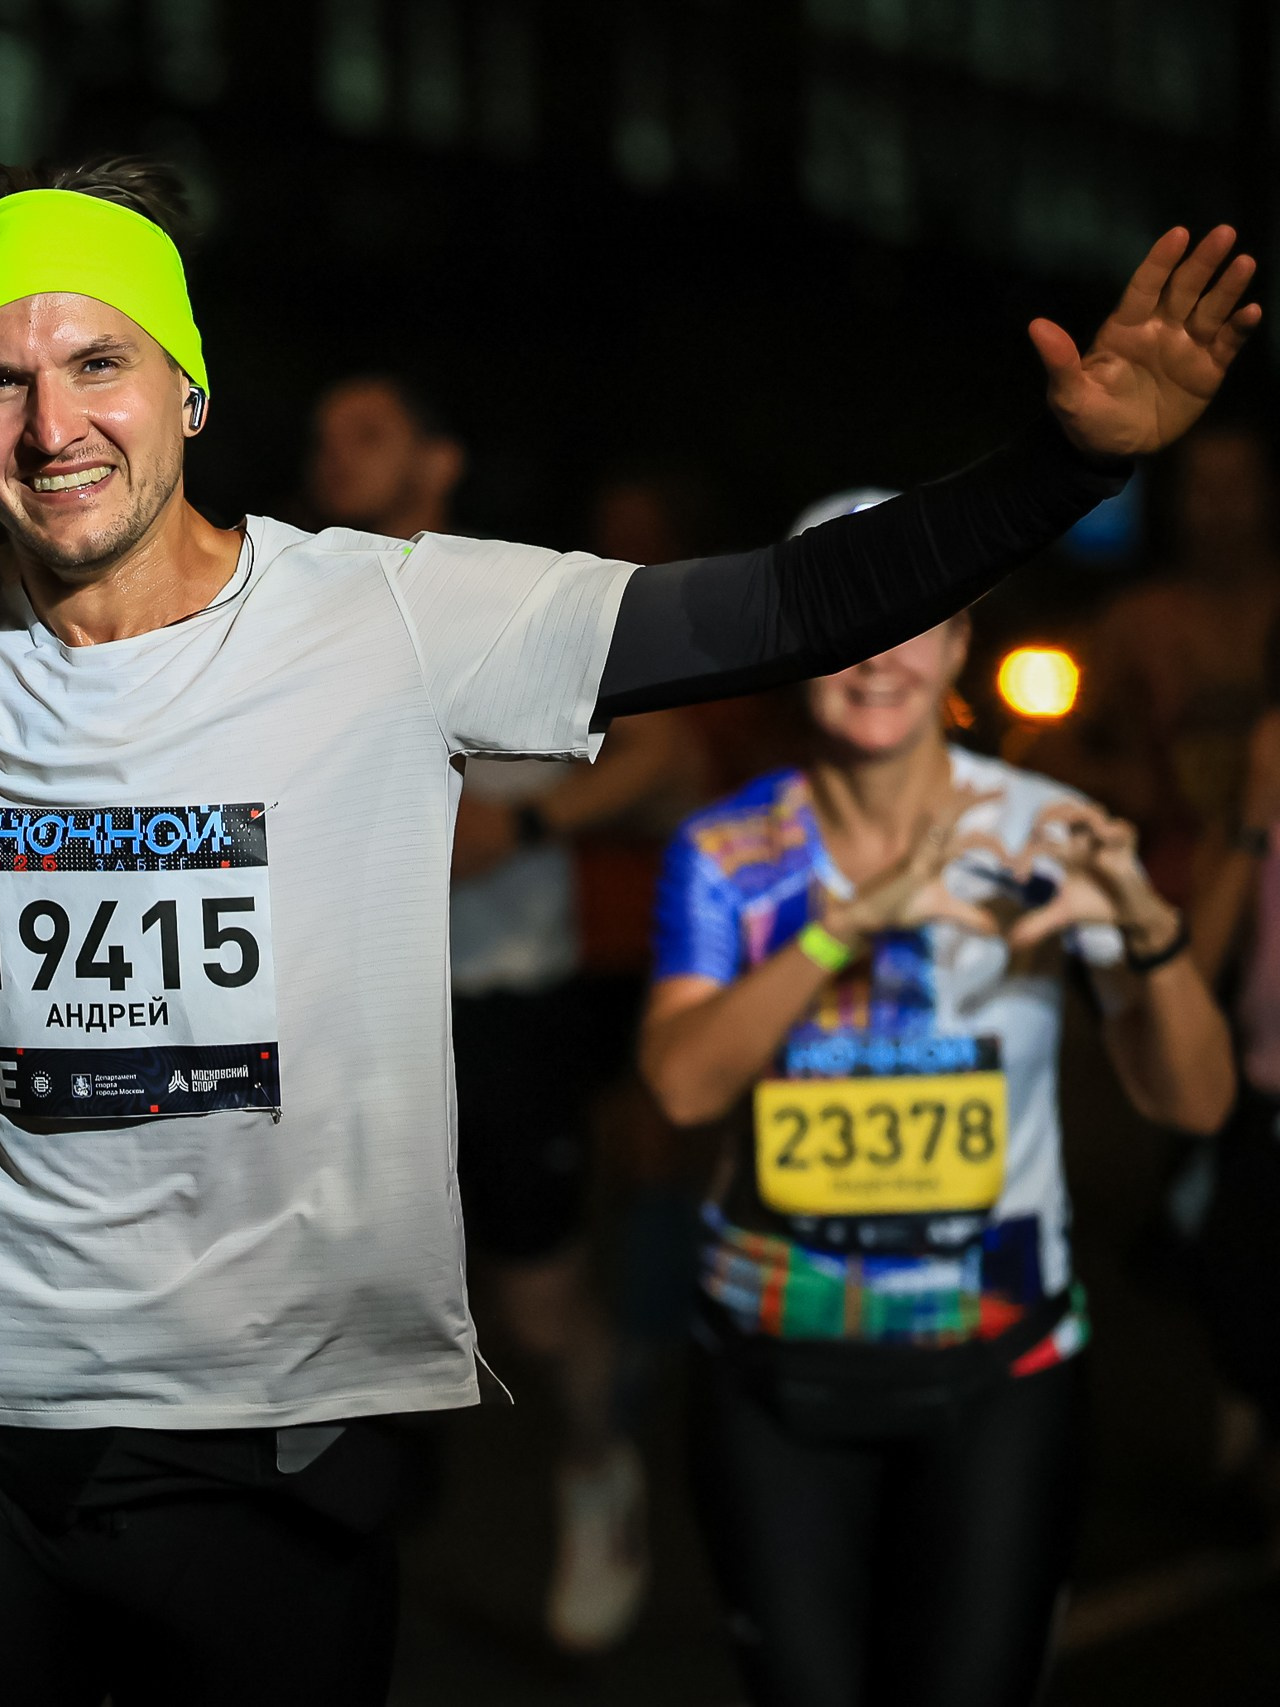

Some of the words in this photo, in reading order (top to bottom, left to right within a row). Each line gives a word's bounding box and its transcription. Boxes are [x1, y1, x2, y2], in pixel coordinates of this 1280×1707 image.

[95, 858, 187, 871] ЗАБЕГ
[46, 996, 168, 1032] АНДРЕЙ
[95, 1074, 137, 1082] Департамент
[191, 1064, 249, 1080] МОСКОВСКИЙ
[192, 1080, 218, 1092] СПОРТ
[774, 1099, 995, 1169] 23378
